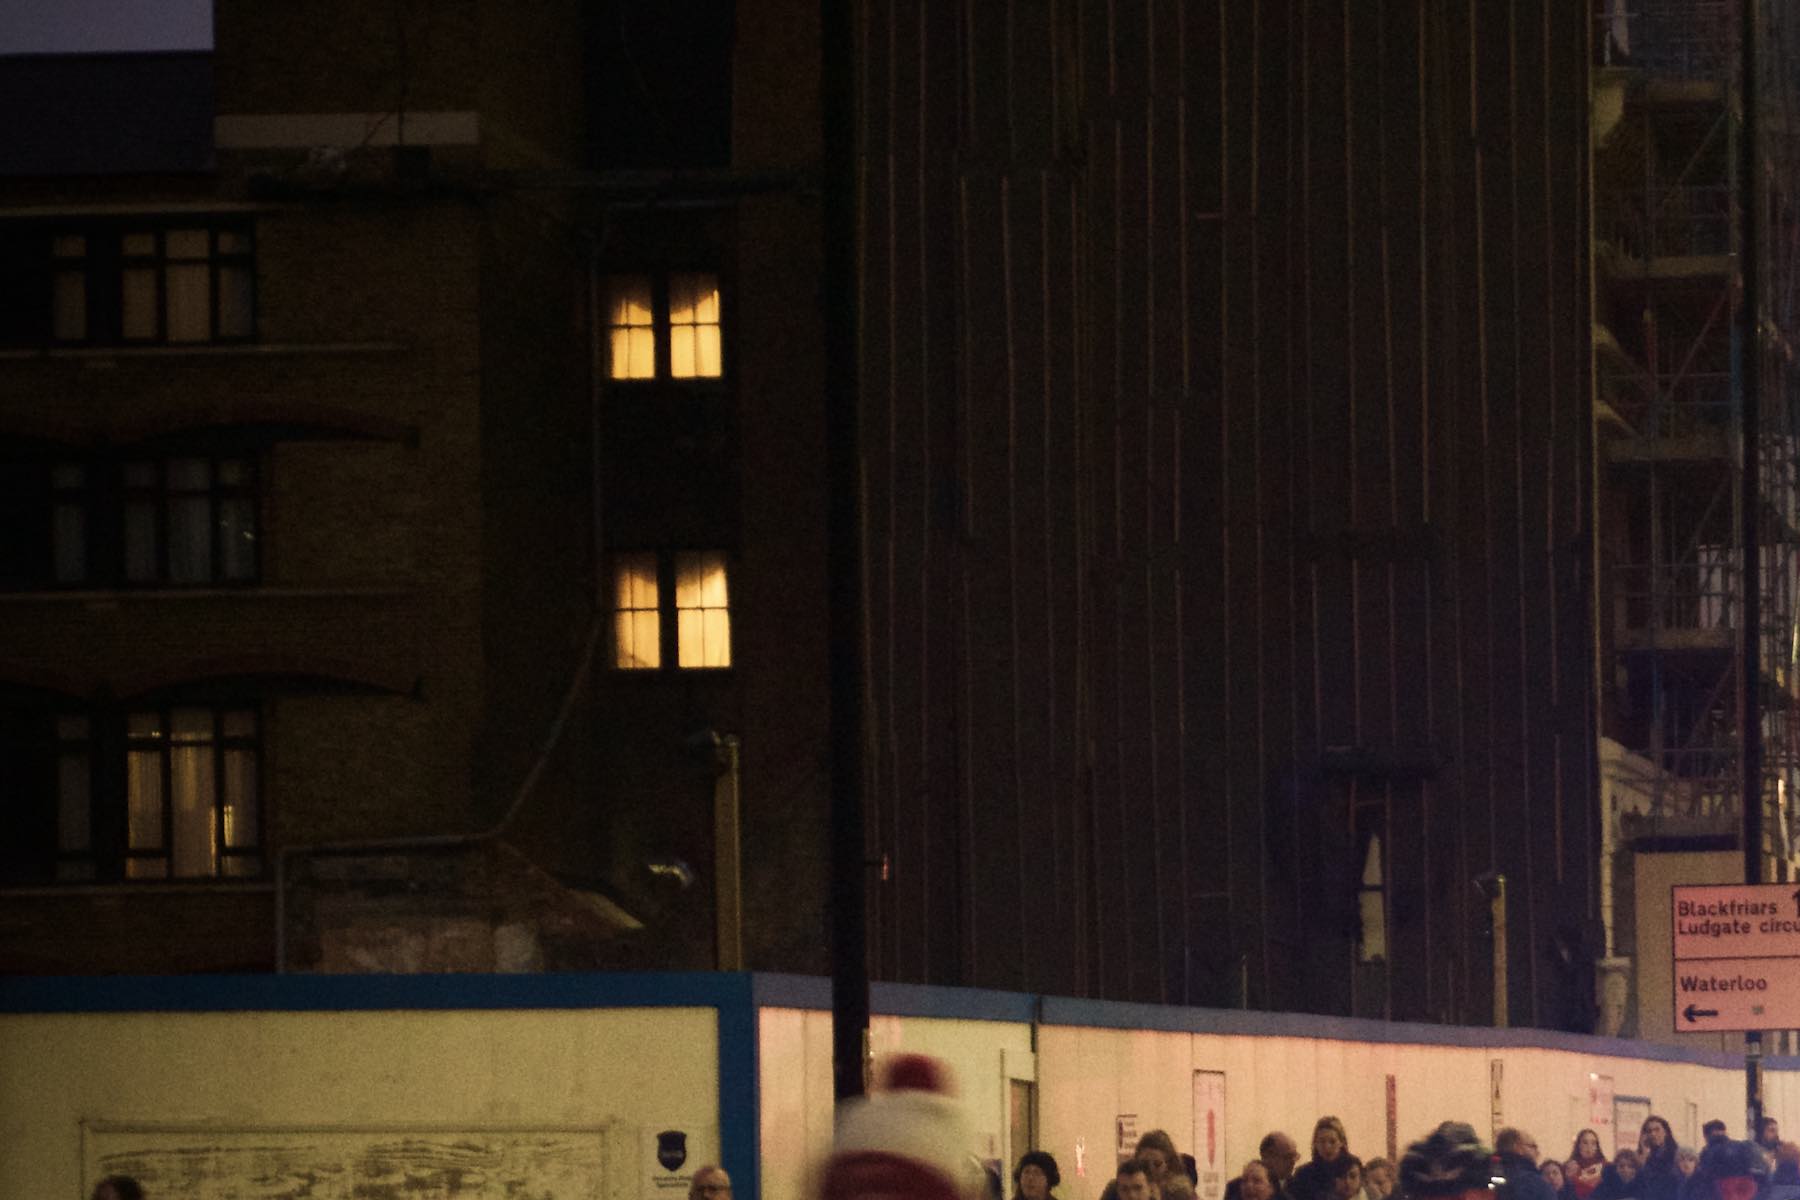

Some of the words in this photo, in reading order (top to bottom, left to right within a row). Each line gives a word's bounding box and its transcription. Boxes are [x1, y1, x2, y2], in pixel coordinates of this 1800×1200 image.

[1677, 899, 1778, 917] Blackfriars
[1678, 919, 1752, 937] Ludgate
[1680, 974, 1768, 992] Waterloo
